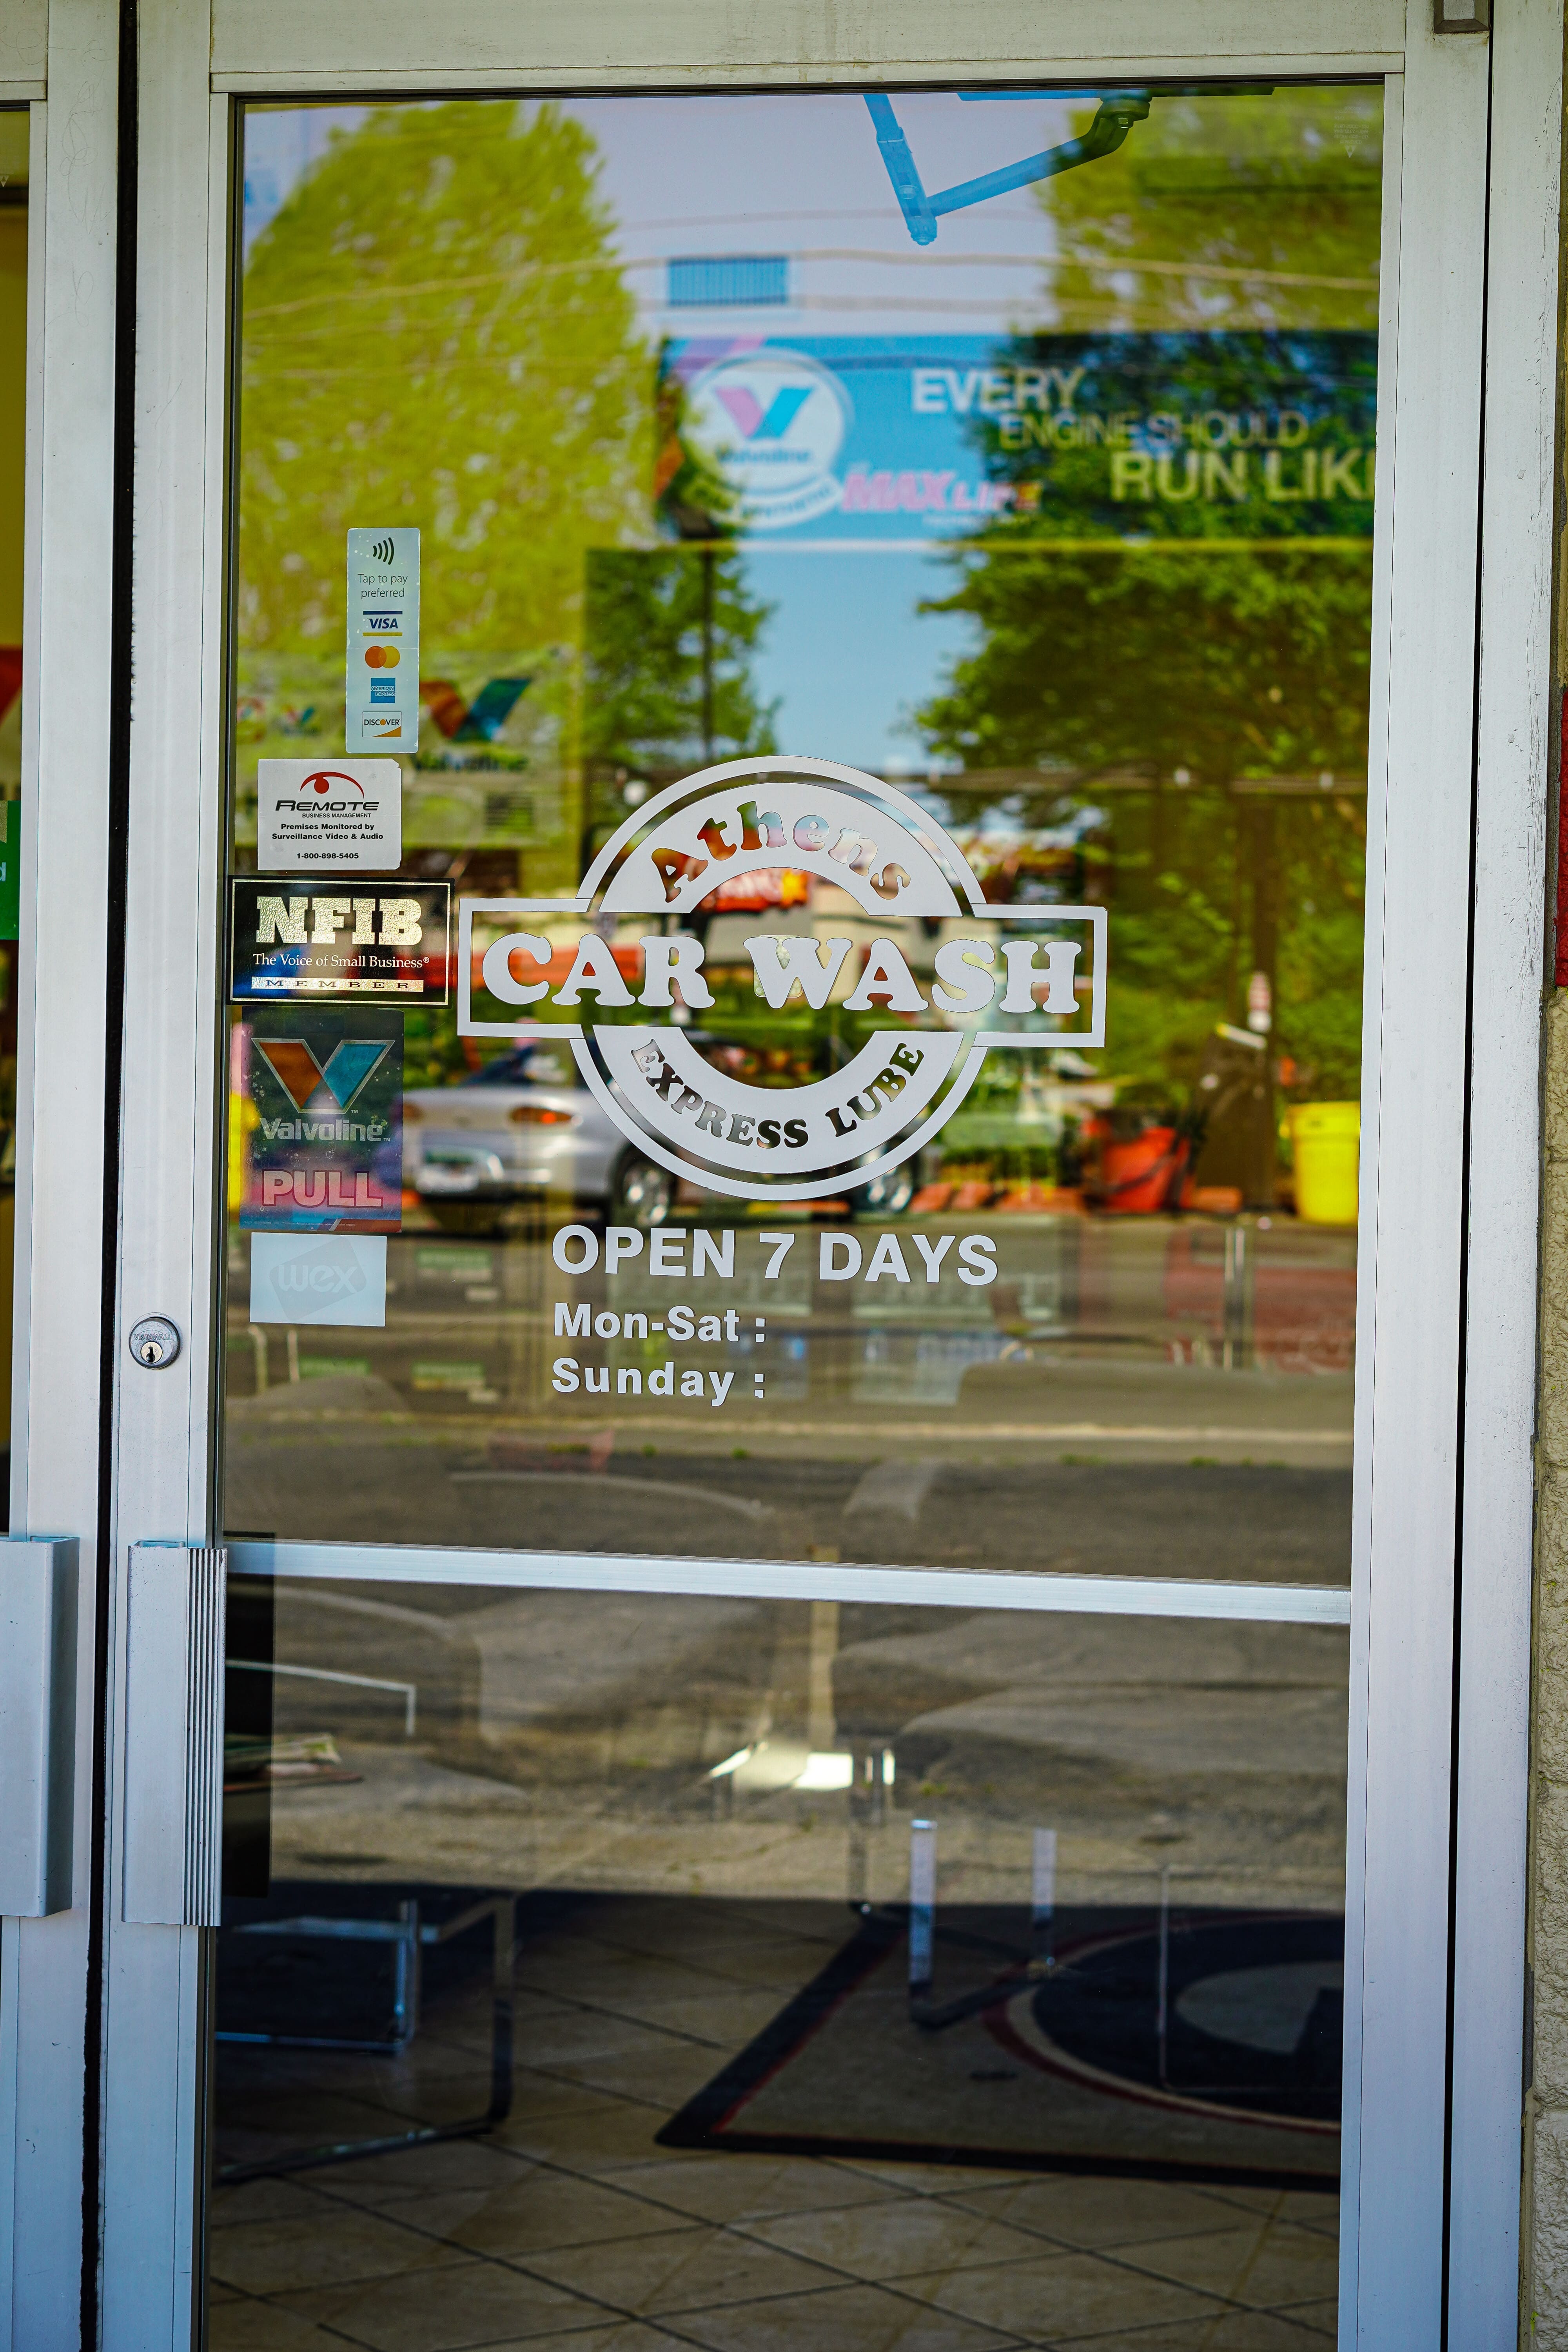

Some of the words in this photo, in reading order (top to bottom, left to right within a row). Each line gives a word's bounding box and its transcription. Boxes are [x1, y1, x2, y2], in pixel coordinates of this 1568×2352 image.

[912, 368, 1086, 413] EVERY
[1000, 412, 1140, 449] ENGINE
[1144, 410, 1308, 447] SHOULD
[1112, 448, 1247, 502] RUN
[1265, 447, 1375, 502] LIK
[358, 573, 374, 584] Tap
[378, 575, 388, 583] to
[390, 575, 408, 585] pay
[361, 588, 405, 599] preferred
[367, 618, 398, 629] VISA
[652, 800, 911, 903] Athens
[256, 896, 422, 946] NFIB
[253, 953, 276, 965] The
[280, 955, 312, 966] Voice
[316, 956, 327, 967] of
[331, 955, 366, 967] Small
[482, 933, 715, 1008] CAR
[744, 936, 1082, 1014] WASH
[266, 980, 410, 989] MEMBER
[631, 1039, 809, 1149] EXPRESS
[825, 1043, 924, 1138] LUBE
[260, 1118, 383, 1142] Valvoline
[262, 1169, 383, 1208] PULL
[552, 1225, 735, 1278] OPEN
[759, 1232, 796, 1279] 7
[820, 1232, 998, 1286] DAYS
[554, 1302, 740, 1342] Mon-Sat
[552, 1357, 735, 1406] Sunday
